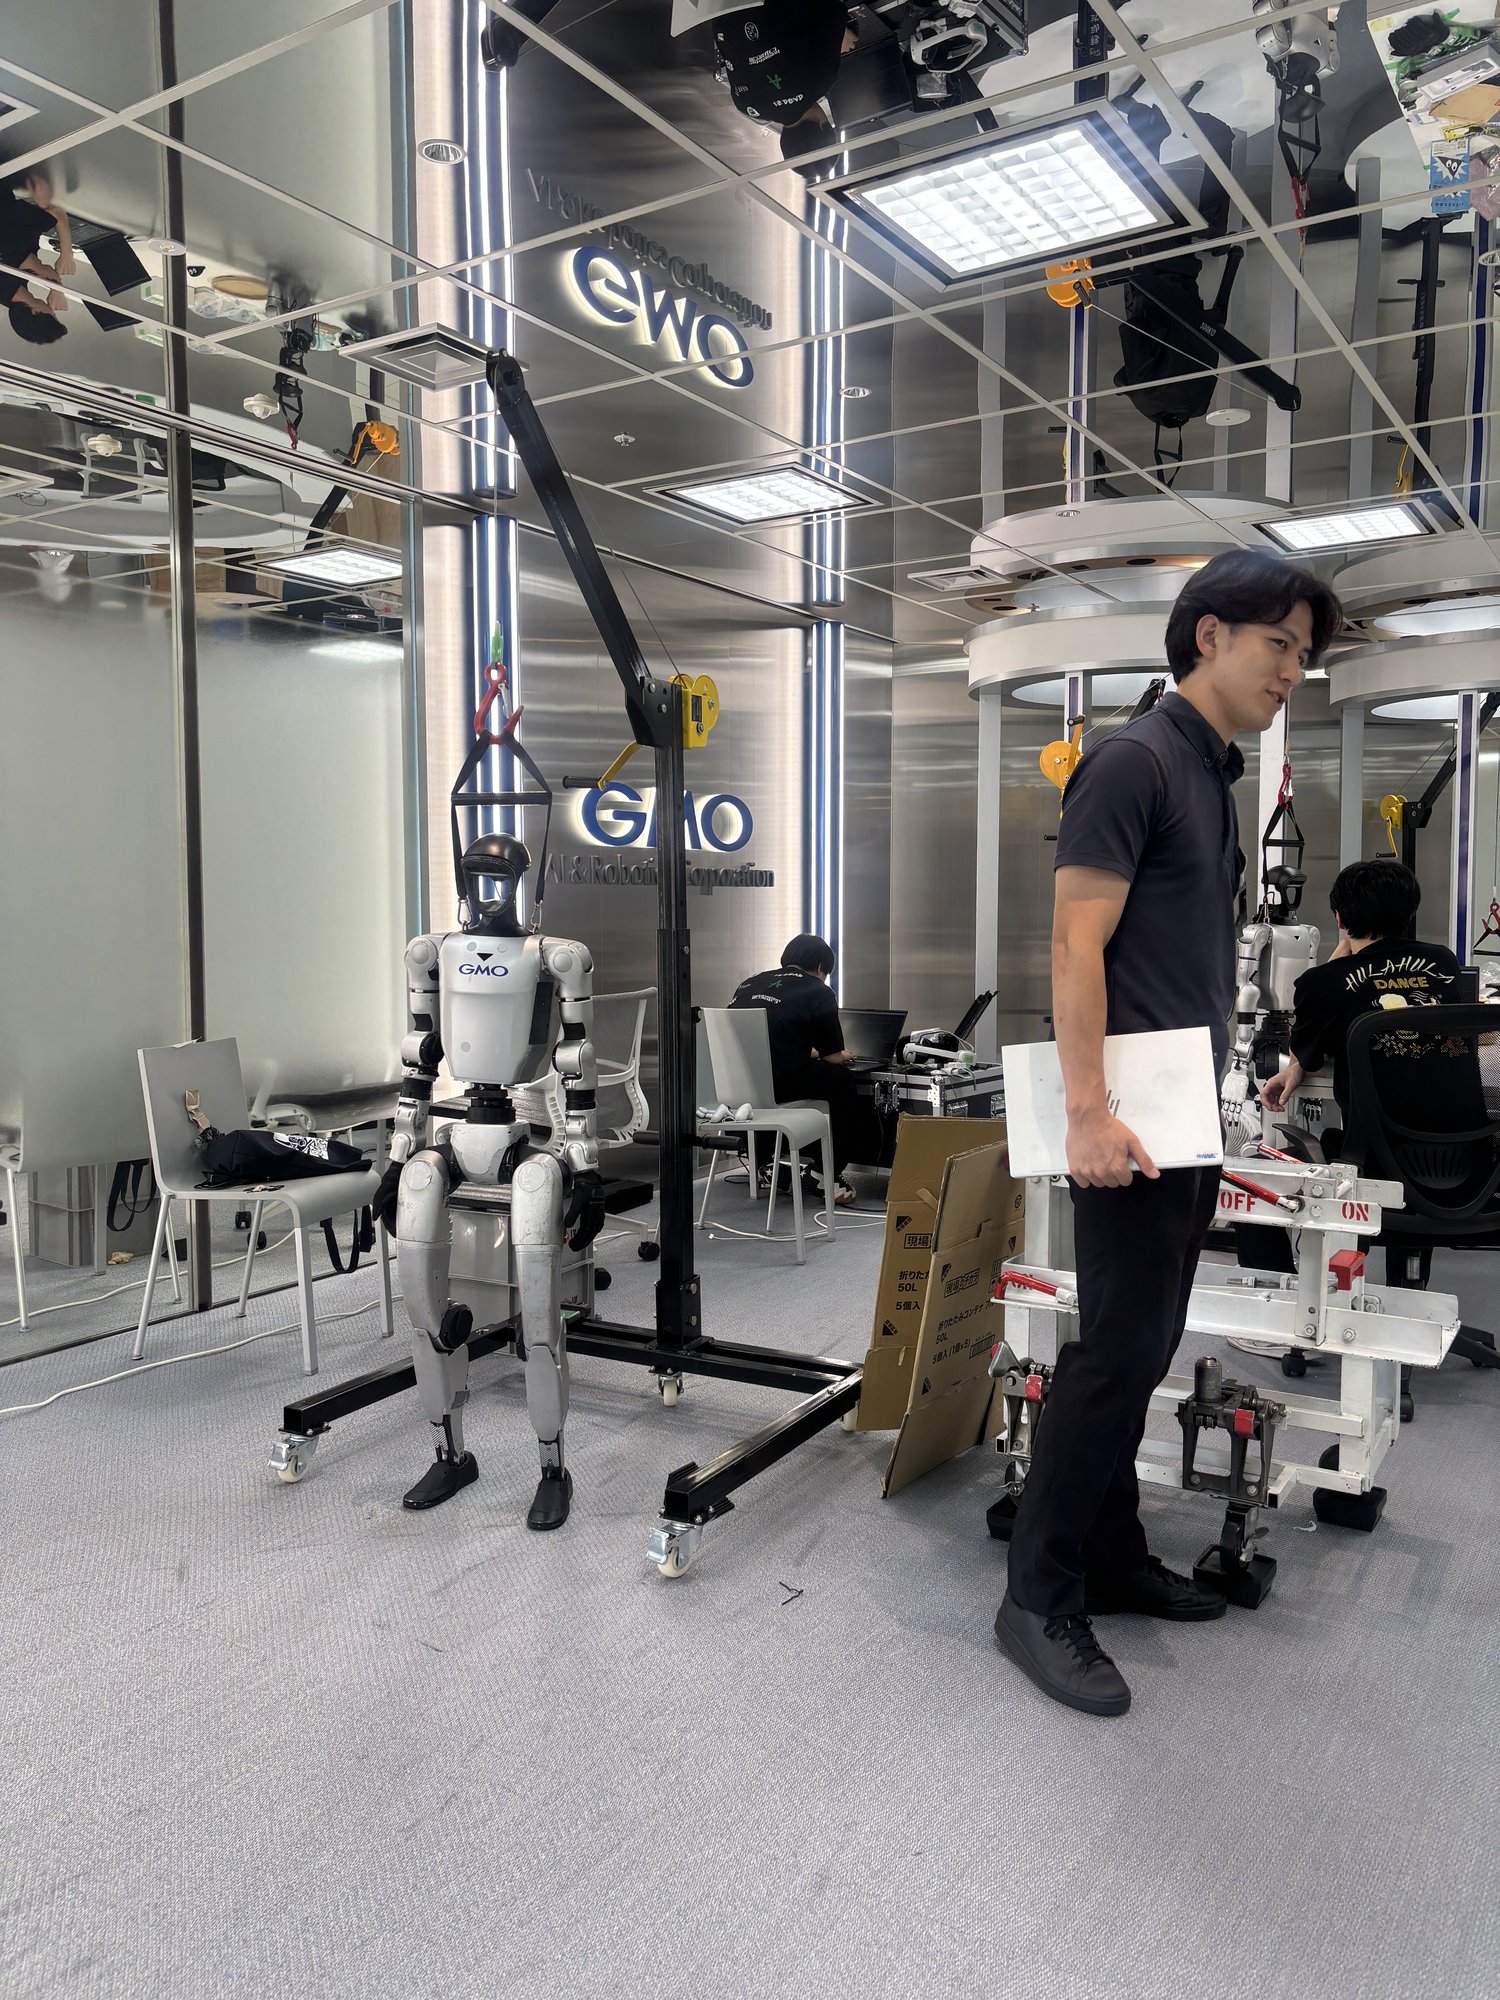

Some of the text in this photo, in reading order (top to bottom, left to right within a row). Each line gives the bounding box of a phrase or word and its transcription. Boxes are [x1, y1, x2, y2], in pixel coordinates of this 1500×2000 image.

[544, 853, 565, 884] AI
[570, 855, 589, 885] &
[590, 854, 658, 886] Roboti
[458, 963, 509, 977] GMO
[1373, 976, 1430, 989] DANCE
[1219, 1191, 1258, 1212] OFF
[1341, 1201, 1369, 1222] ON
[897, 1282, 918, 1292] 50L
[895, 1300, 921, 1311] 5個入
[935, 1332, 948, 1345] 50L
